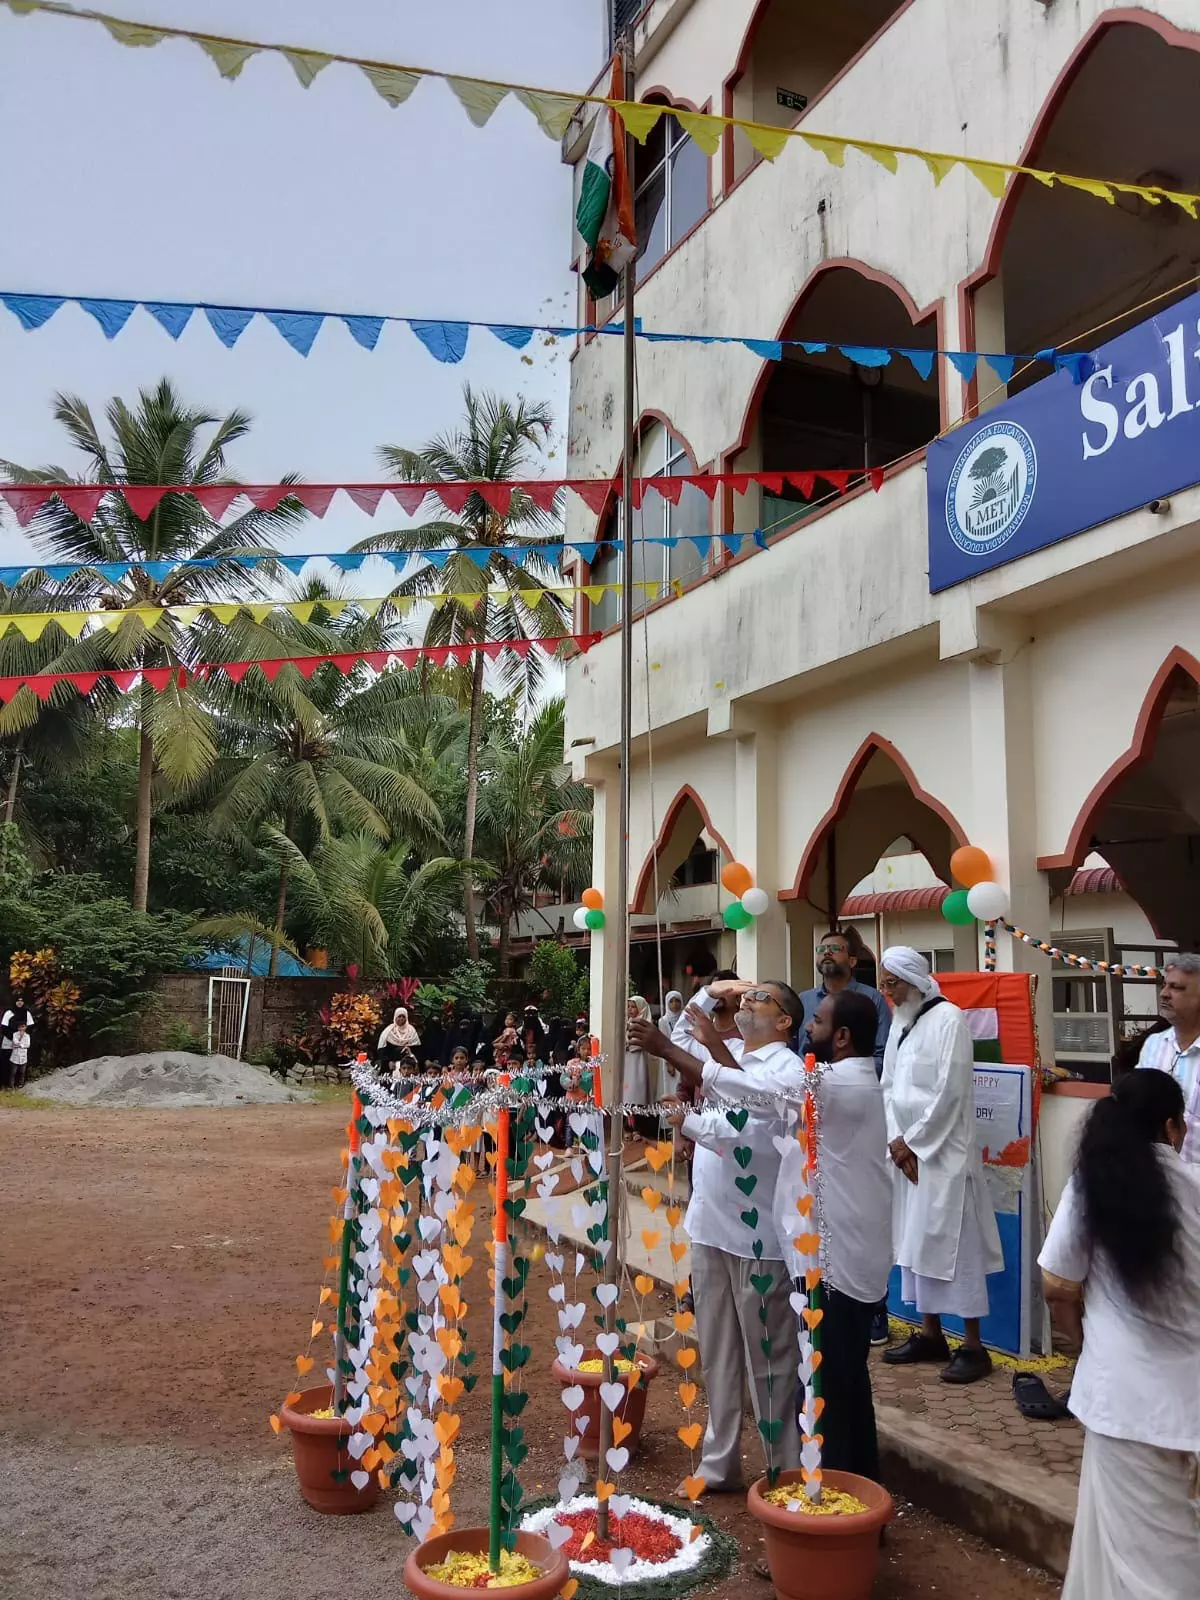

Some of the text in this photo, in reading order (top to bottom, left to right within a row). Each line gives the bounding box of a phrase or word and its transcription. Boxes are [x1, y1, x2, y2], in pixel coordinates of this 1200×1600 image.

[951, 424, 1035, 488] MOHAMMADIA EDUCATION TRUST
[976, 498, 1006, 526] MET
[953, 528, 985, 553] EDUCATION
[976, 1107, 993, 1118] DAY
